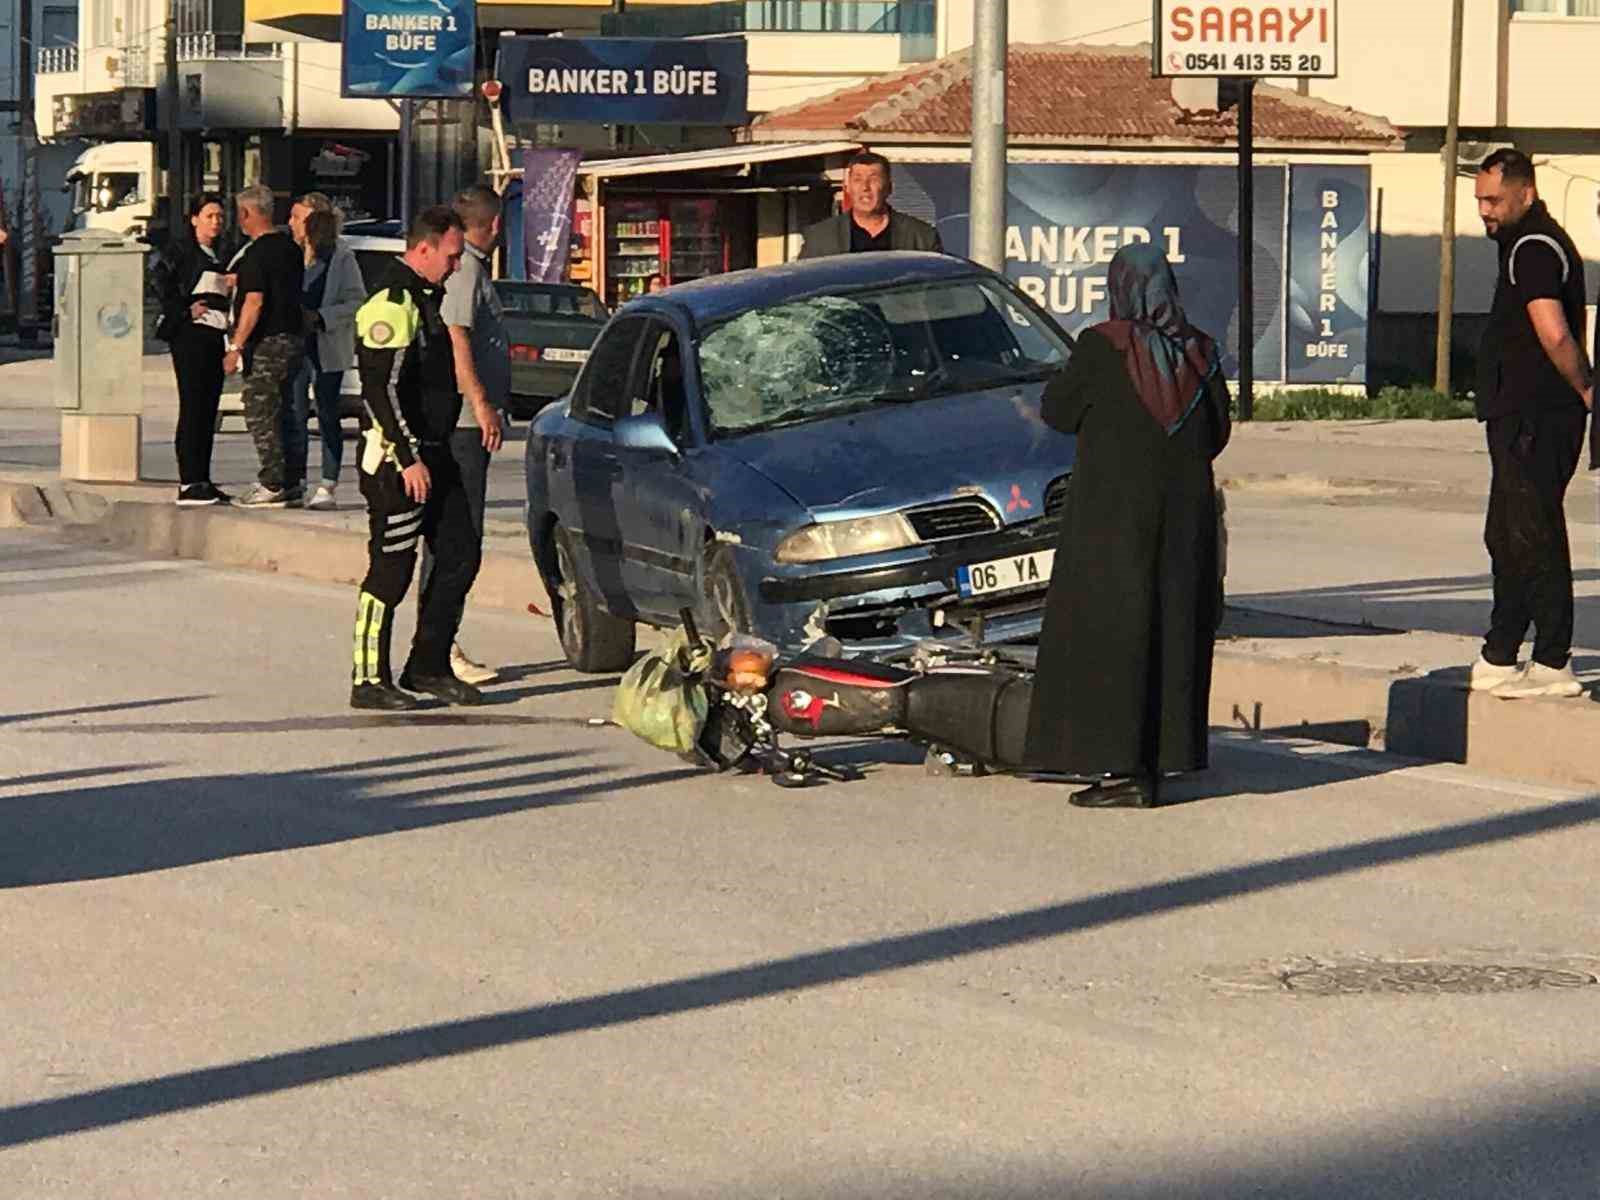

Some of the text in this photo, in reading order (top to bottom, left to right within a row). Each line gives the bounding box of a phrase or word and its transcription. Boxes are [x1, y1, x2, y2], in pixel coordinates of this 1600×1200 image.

[365, 13, 458, 31] BANKER 1
[1170, 6, 1327, 43] SARAYI
[386, 32, 437, 51] BÜFE
[1185, 53, 1321, 71] 0541 413 55 20
[528, 65, 718, 95] BANKER 1 BÜFE
[1163, 226, 1186, 263] 1
[1306, 342, 1348, 358] BÜFE
[971, 556, 1040, 590] 06 YA
